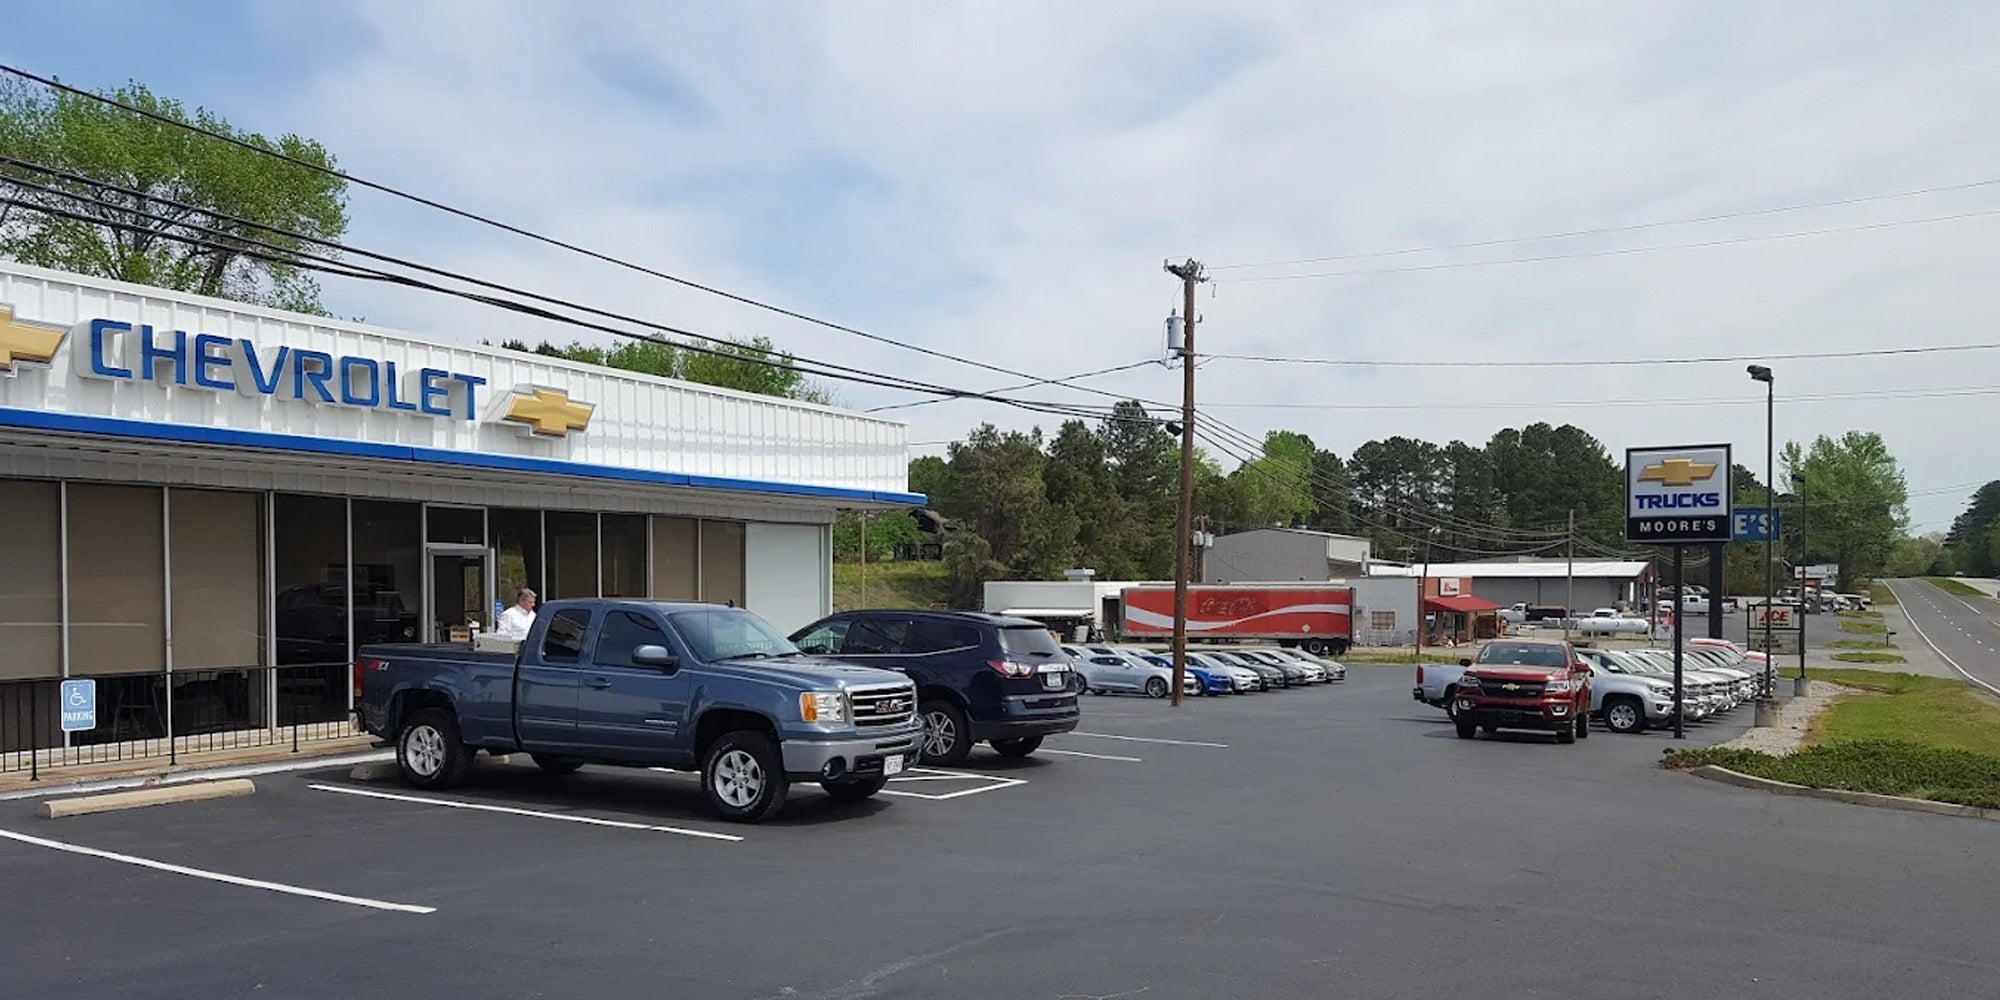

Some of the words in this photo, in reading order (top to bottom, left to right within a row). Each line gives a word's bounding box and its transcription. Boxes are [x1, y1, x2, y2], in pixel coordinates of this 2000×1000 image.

[91, 318, 487, 420] CHEVROLET
[1635, 493, 1720, 509] TRUCKS
[1640, 520, 1716, 532] MOORE'S
[64, 711, 93, 721] PARKING
